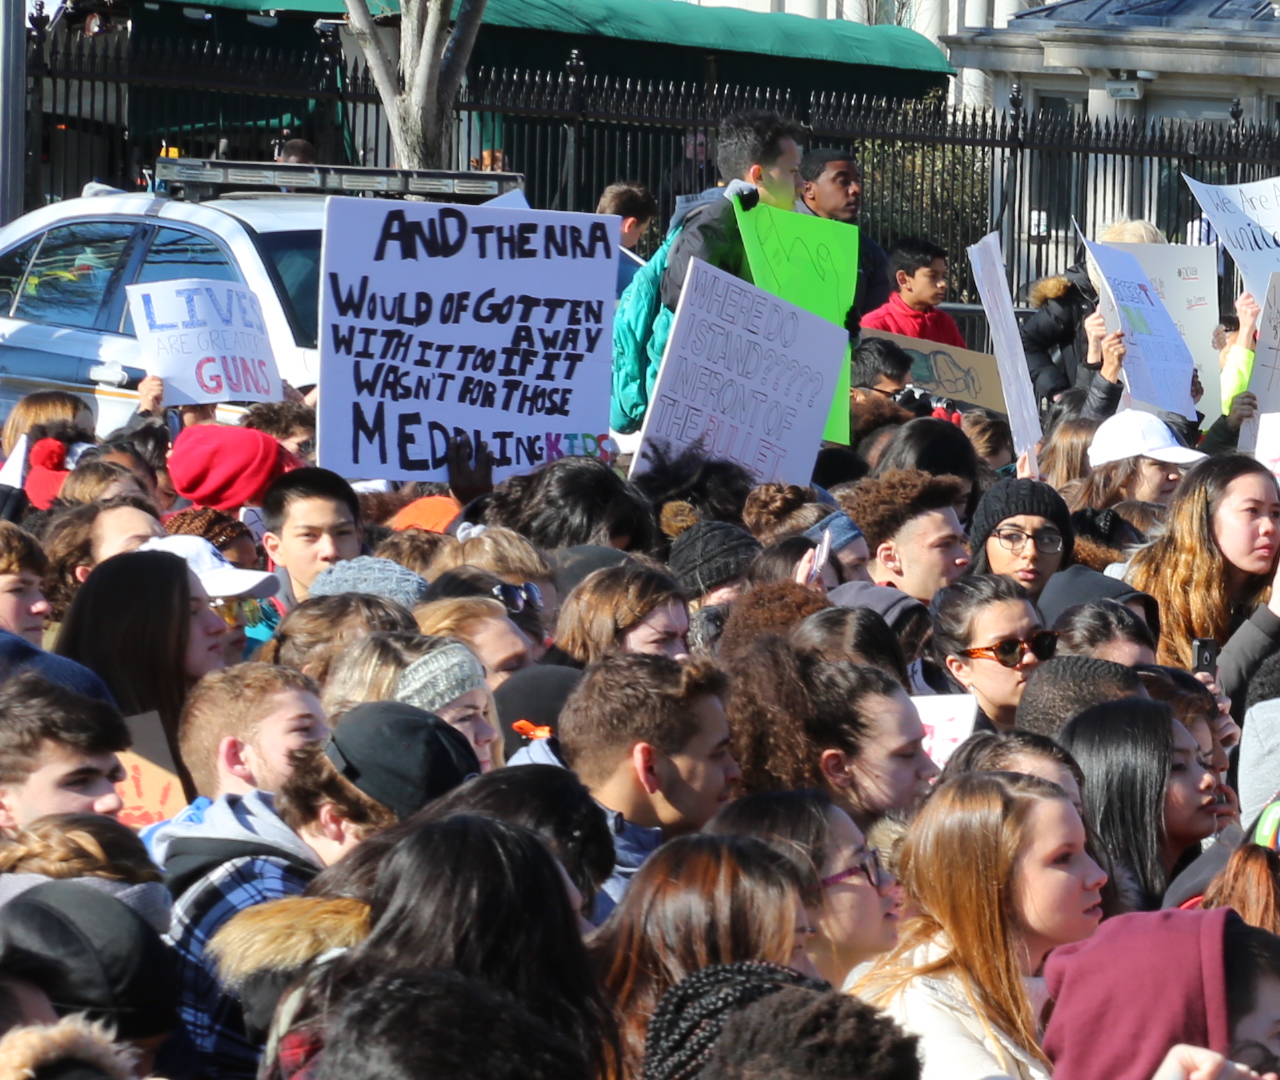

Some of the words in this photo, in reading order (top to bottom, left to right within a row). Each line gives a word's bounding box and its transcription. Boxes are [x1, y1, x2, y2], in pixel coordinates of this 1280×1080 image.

[1206, 189, 1236, 215] We
[1238, 188, 1272, 213] Are
[374, 208, 468, 261] AND
[471, 223, 538, 259] THE
[544, 222, 612, 259] NRA
[141, 287, 265, 335] LIVES
[329, 272, 433, 327] WOULD
[440, 291, 471, 325] OF
[473, 288, 604, 326] GOTTEN
[689, 266, 768, 336] WHERE
[764, 304, 798, 348] DO
[157, 333, 193, 358] ARE
[331, 324, 414, 363] WITH
[413, 340, 453, 369] IT
[456, 345, 496, 373] TOO
[498, 347, 539, 378] IF
[535, 352, 585, 382] IT
[511, 326, 603, 353] AWAY
[682, 313, 696, 349] I
[195, 355, 271, 396] GUNS
[353, 360, 456, 402] WASN'T
[457, 376, 497, 408] FOR
[502, 379, 573, 417] THOSE
[656, 394, 703, 444] THE
[763, 400, 797, 442] OF
